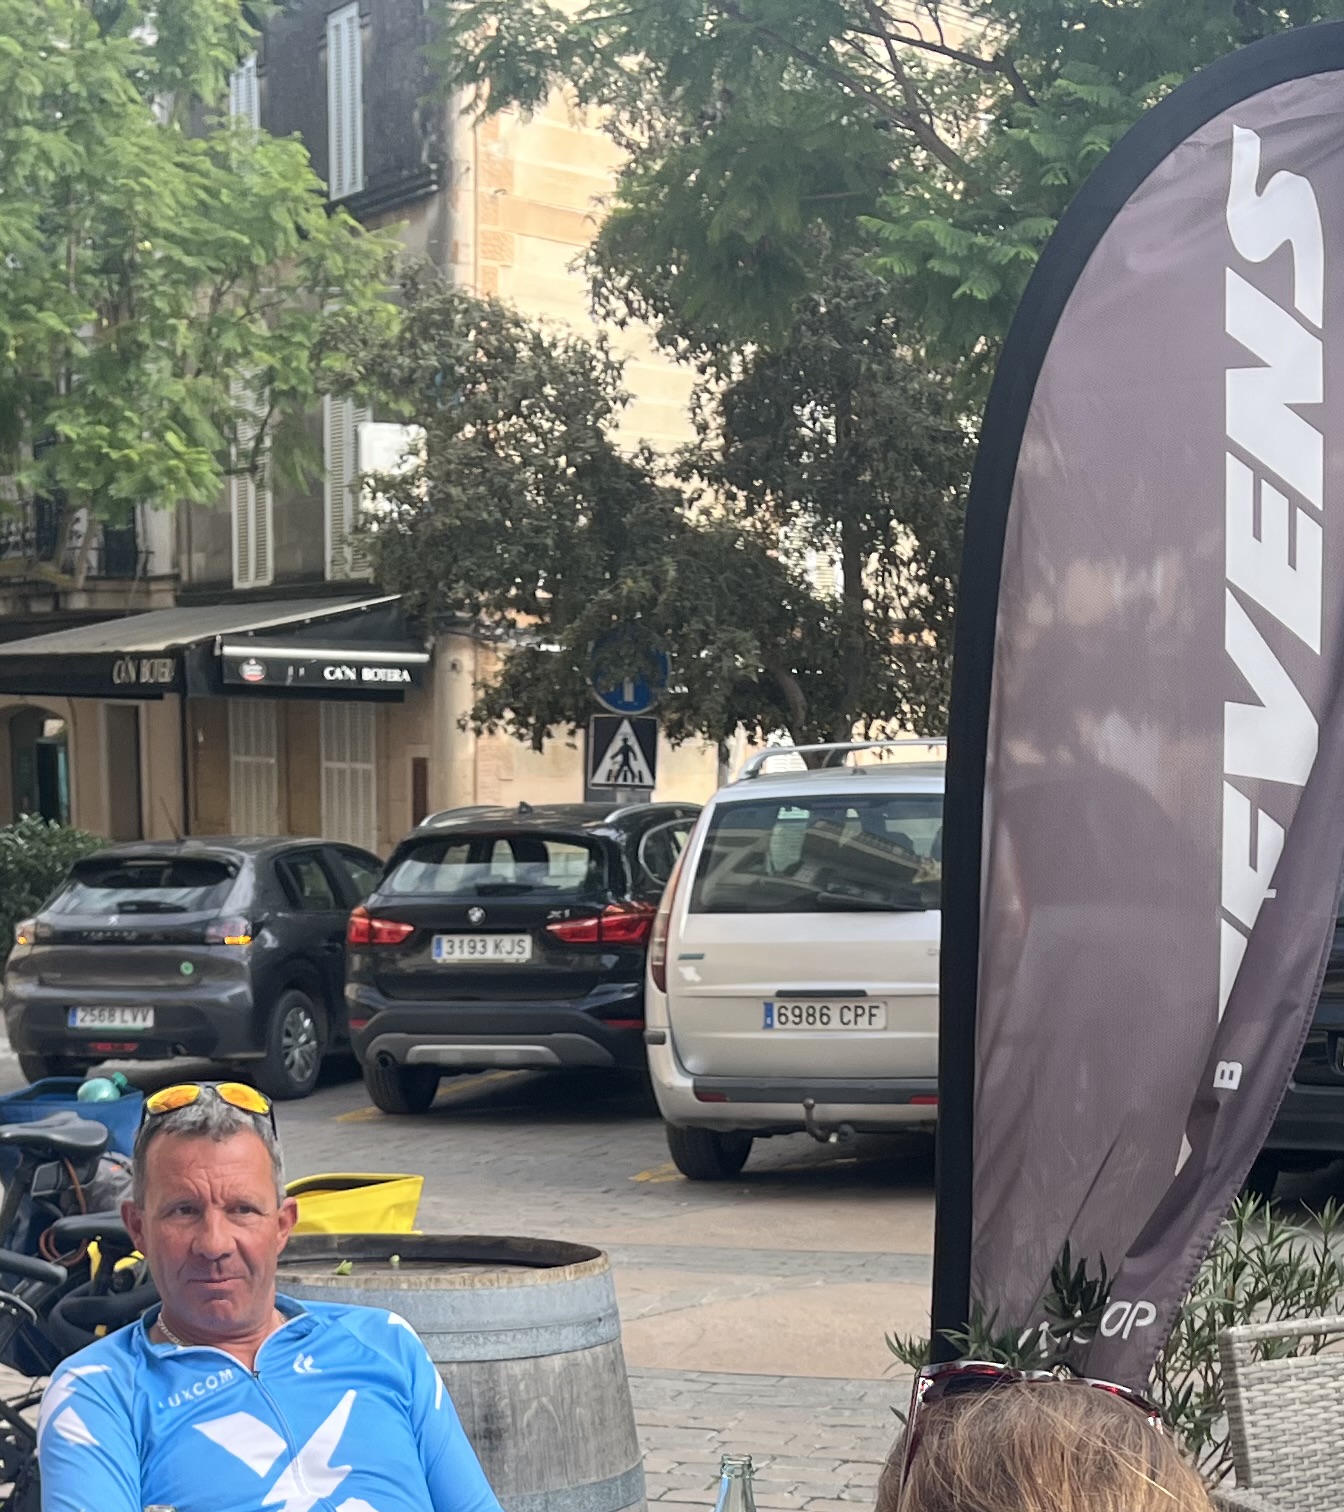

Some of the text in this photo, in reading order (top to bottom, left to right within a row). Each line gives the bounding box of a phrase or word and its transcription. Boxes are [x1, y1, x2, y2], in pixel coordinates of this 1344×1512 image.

[322, 664, 411, 683] CA'N BOTERA
[445, 939, 526, 956] 3193 KJS
[777, 1005, 881, 1026] 6986 CPF
